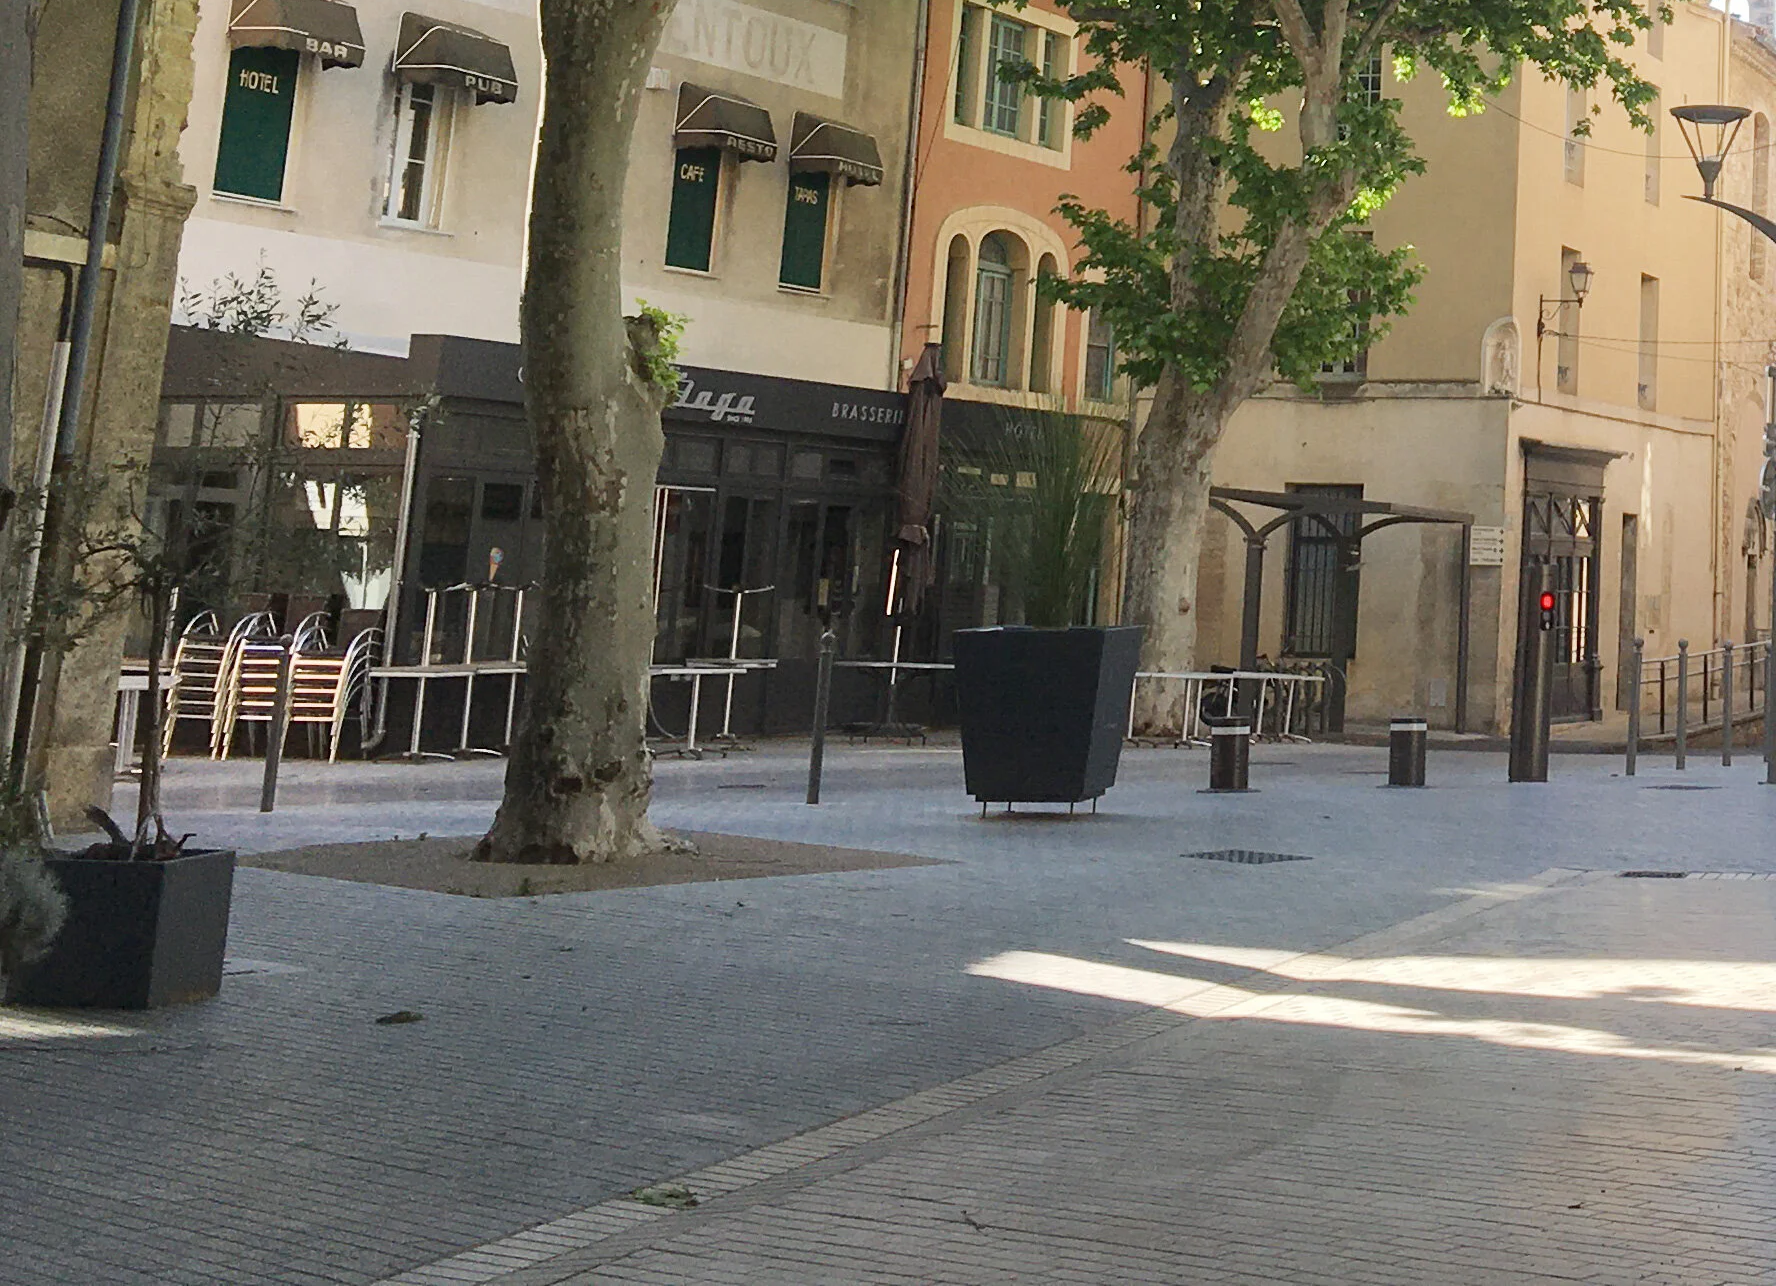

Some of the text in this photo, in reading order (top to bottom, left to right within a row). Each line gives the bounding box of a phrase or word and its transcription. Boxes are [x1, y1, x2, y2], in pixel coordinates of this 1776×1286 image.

[305, 37, 349, 58] BAR
[239, 69, 279, 94] HOTEL
[465, 75, 503, 95] PUB
[727, 137, 774, 158] RESTO
[795, 186, 818, 205] TAPAS
